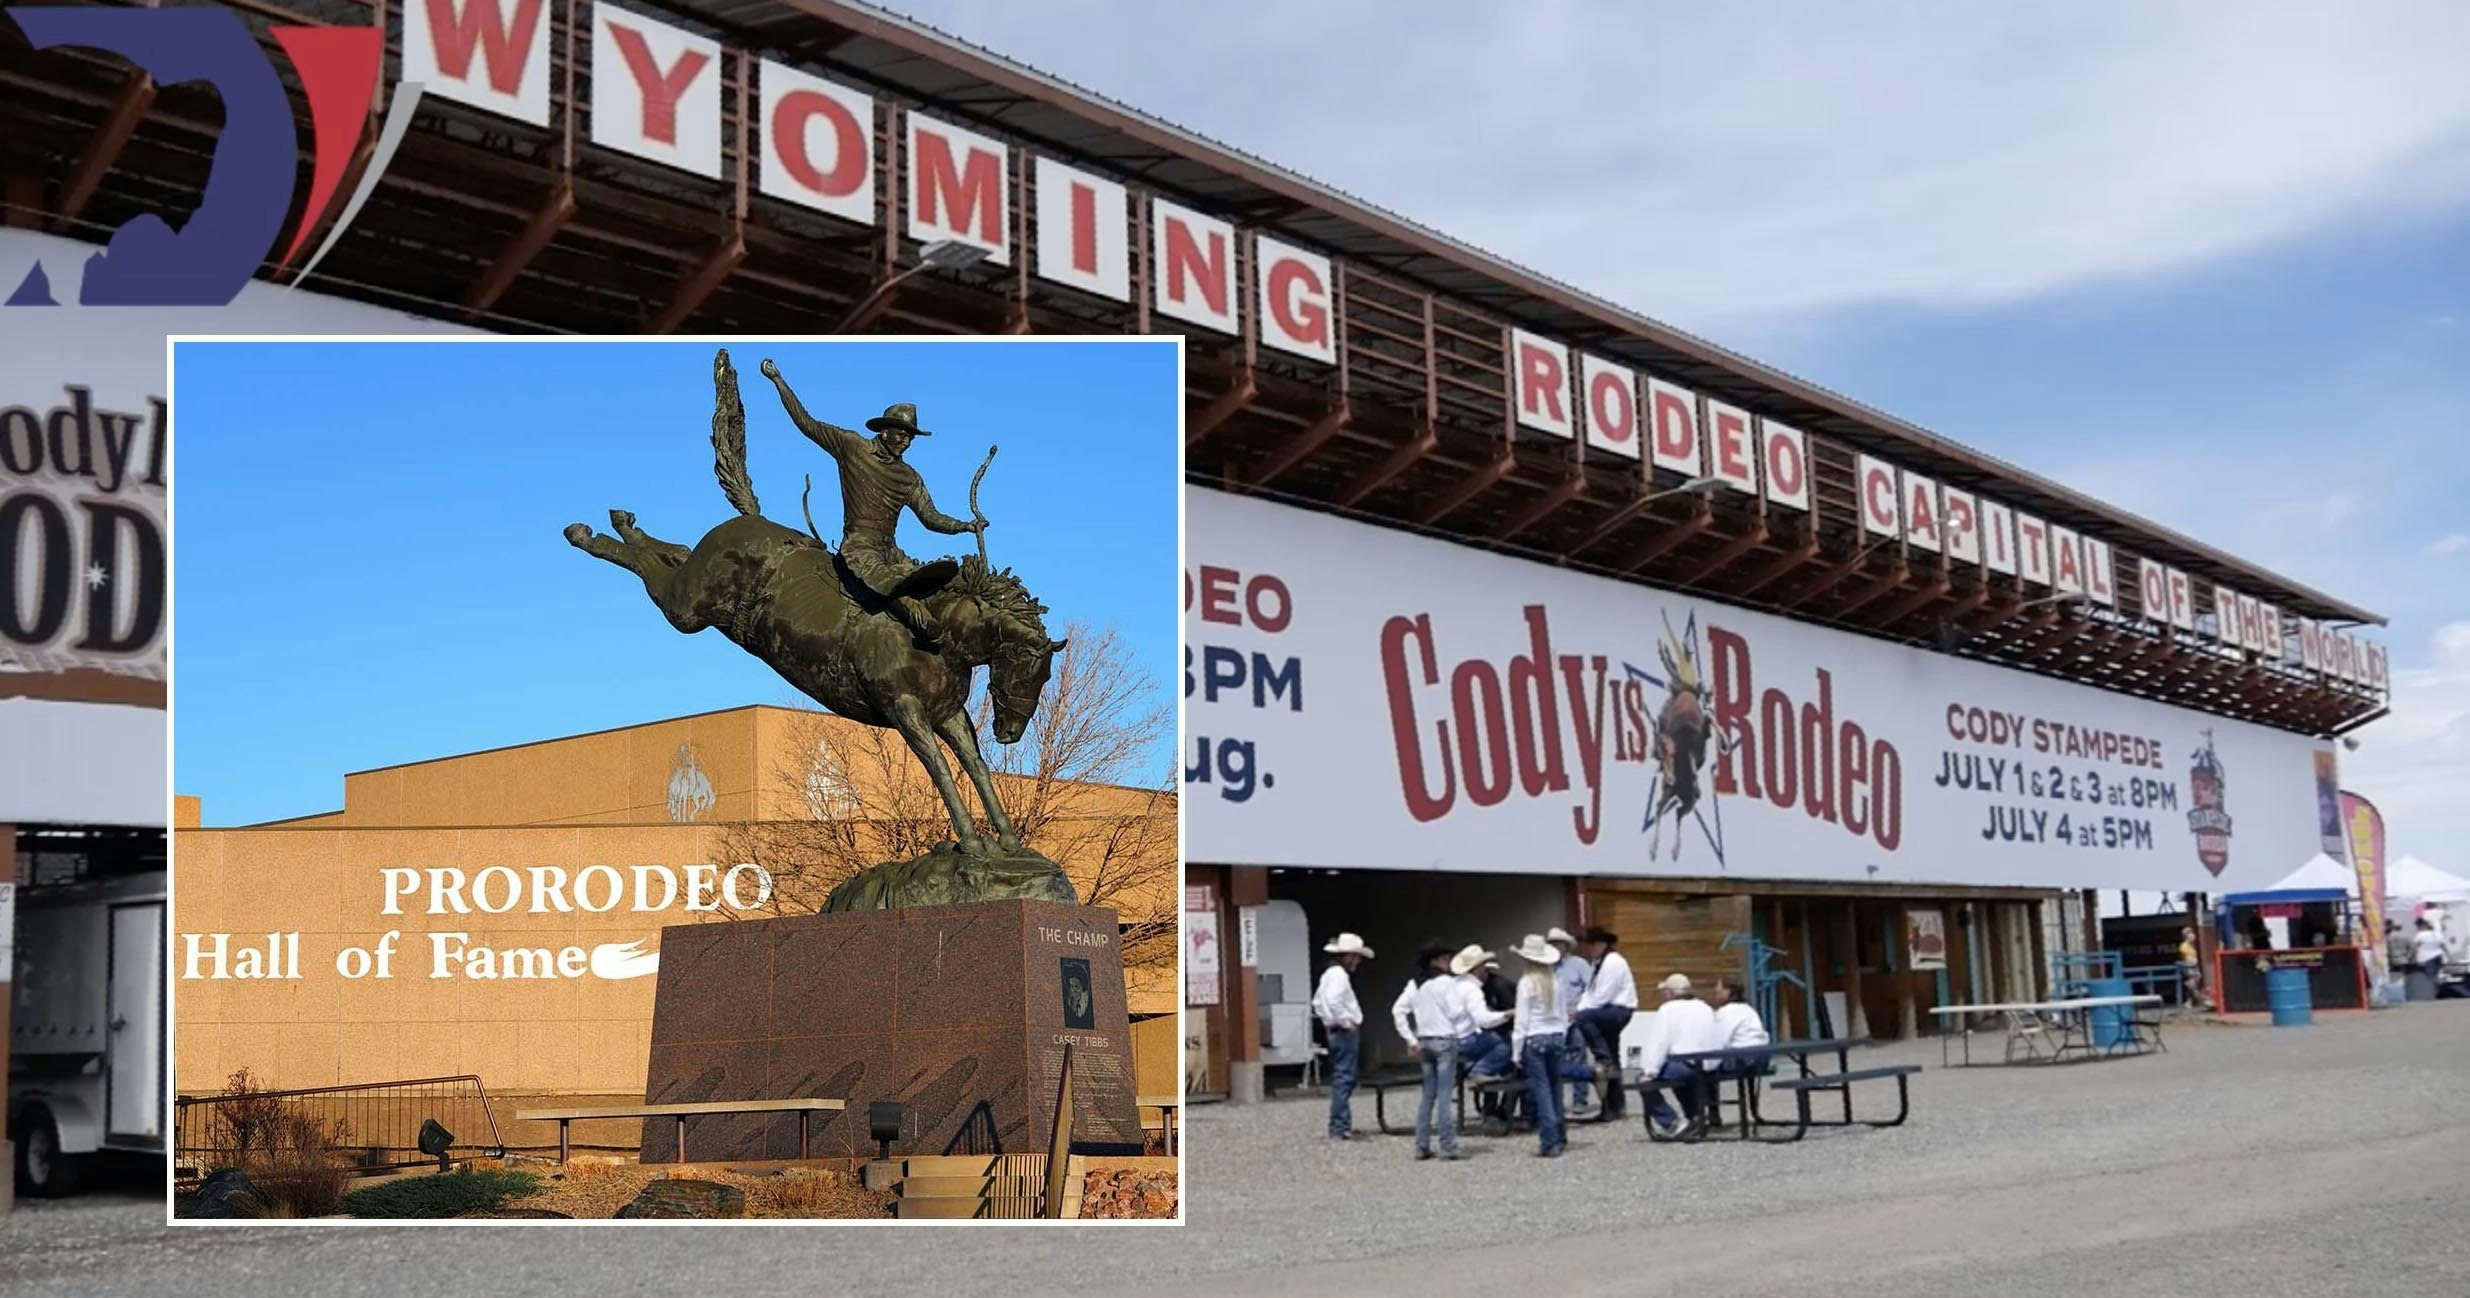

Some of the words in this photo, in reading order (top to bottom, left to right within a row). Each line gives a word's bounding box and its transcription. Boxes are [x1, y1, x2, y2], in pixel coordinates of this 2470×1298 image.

[424, 0, 1328, 350] WYOMING
[1521, 342, 1803, 496] RODEO
[1866, 467, 2109, 596] CAPITAL
[2146, 567, 2187, 622] OF
[2219, 594, 2281, 650] THE
[2301, 624, 2384, 683] WORLD
[1185, 564, 1292, 633] EO
[1381, 604, 1608, 846] Cody
[1707, 625, 1902, 852] Rodeo
[1946, 703, 2025, 749] CODY
[2033, 718, 2164, 770] STAMPEDE
[1935, 751, 2006, 792] JULY
[2013, 762, 2025, 796] 1
[2031, 771, 2044, 798] &
[2049, 766, 2065, 799] 2
[2071, 776, 2083, 802] &
[2087, 771, 2103, 804] 3
[2107, 784, 2126, 806] at
[2130, 777, 2178, 811] 8PM
[1982, 805, 2048, 843] JULY
[2055, 813, 2073, 845] 4
[2079, 824, 2098, 847] at
[2103, 816, 2154, 850] 5PM
[380, 863, 774, 915] PRORODEO
[181, 932, 302, 980] Hall
[336, 930, 401, 980] of
[428, 932, 588, 980] Fame
[1038, 926, 1062, 944] THE
[1067, 930, 1109, 948] CHAMP
[1052, 1033, 1081, 1047] CASEY
[1084, 1036, 1109, 1048] TIBBS
